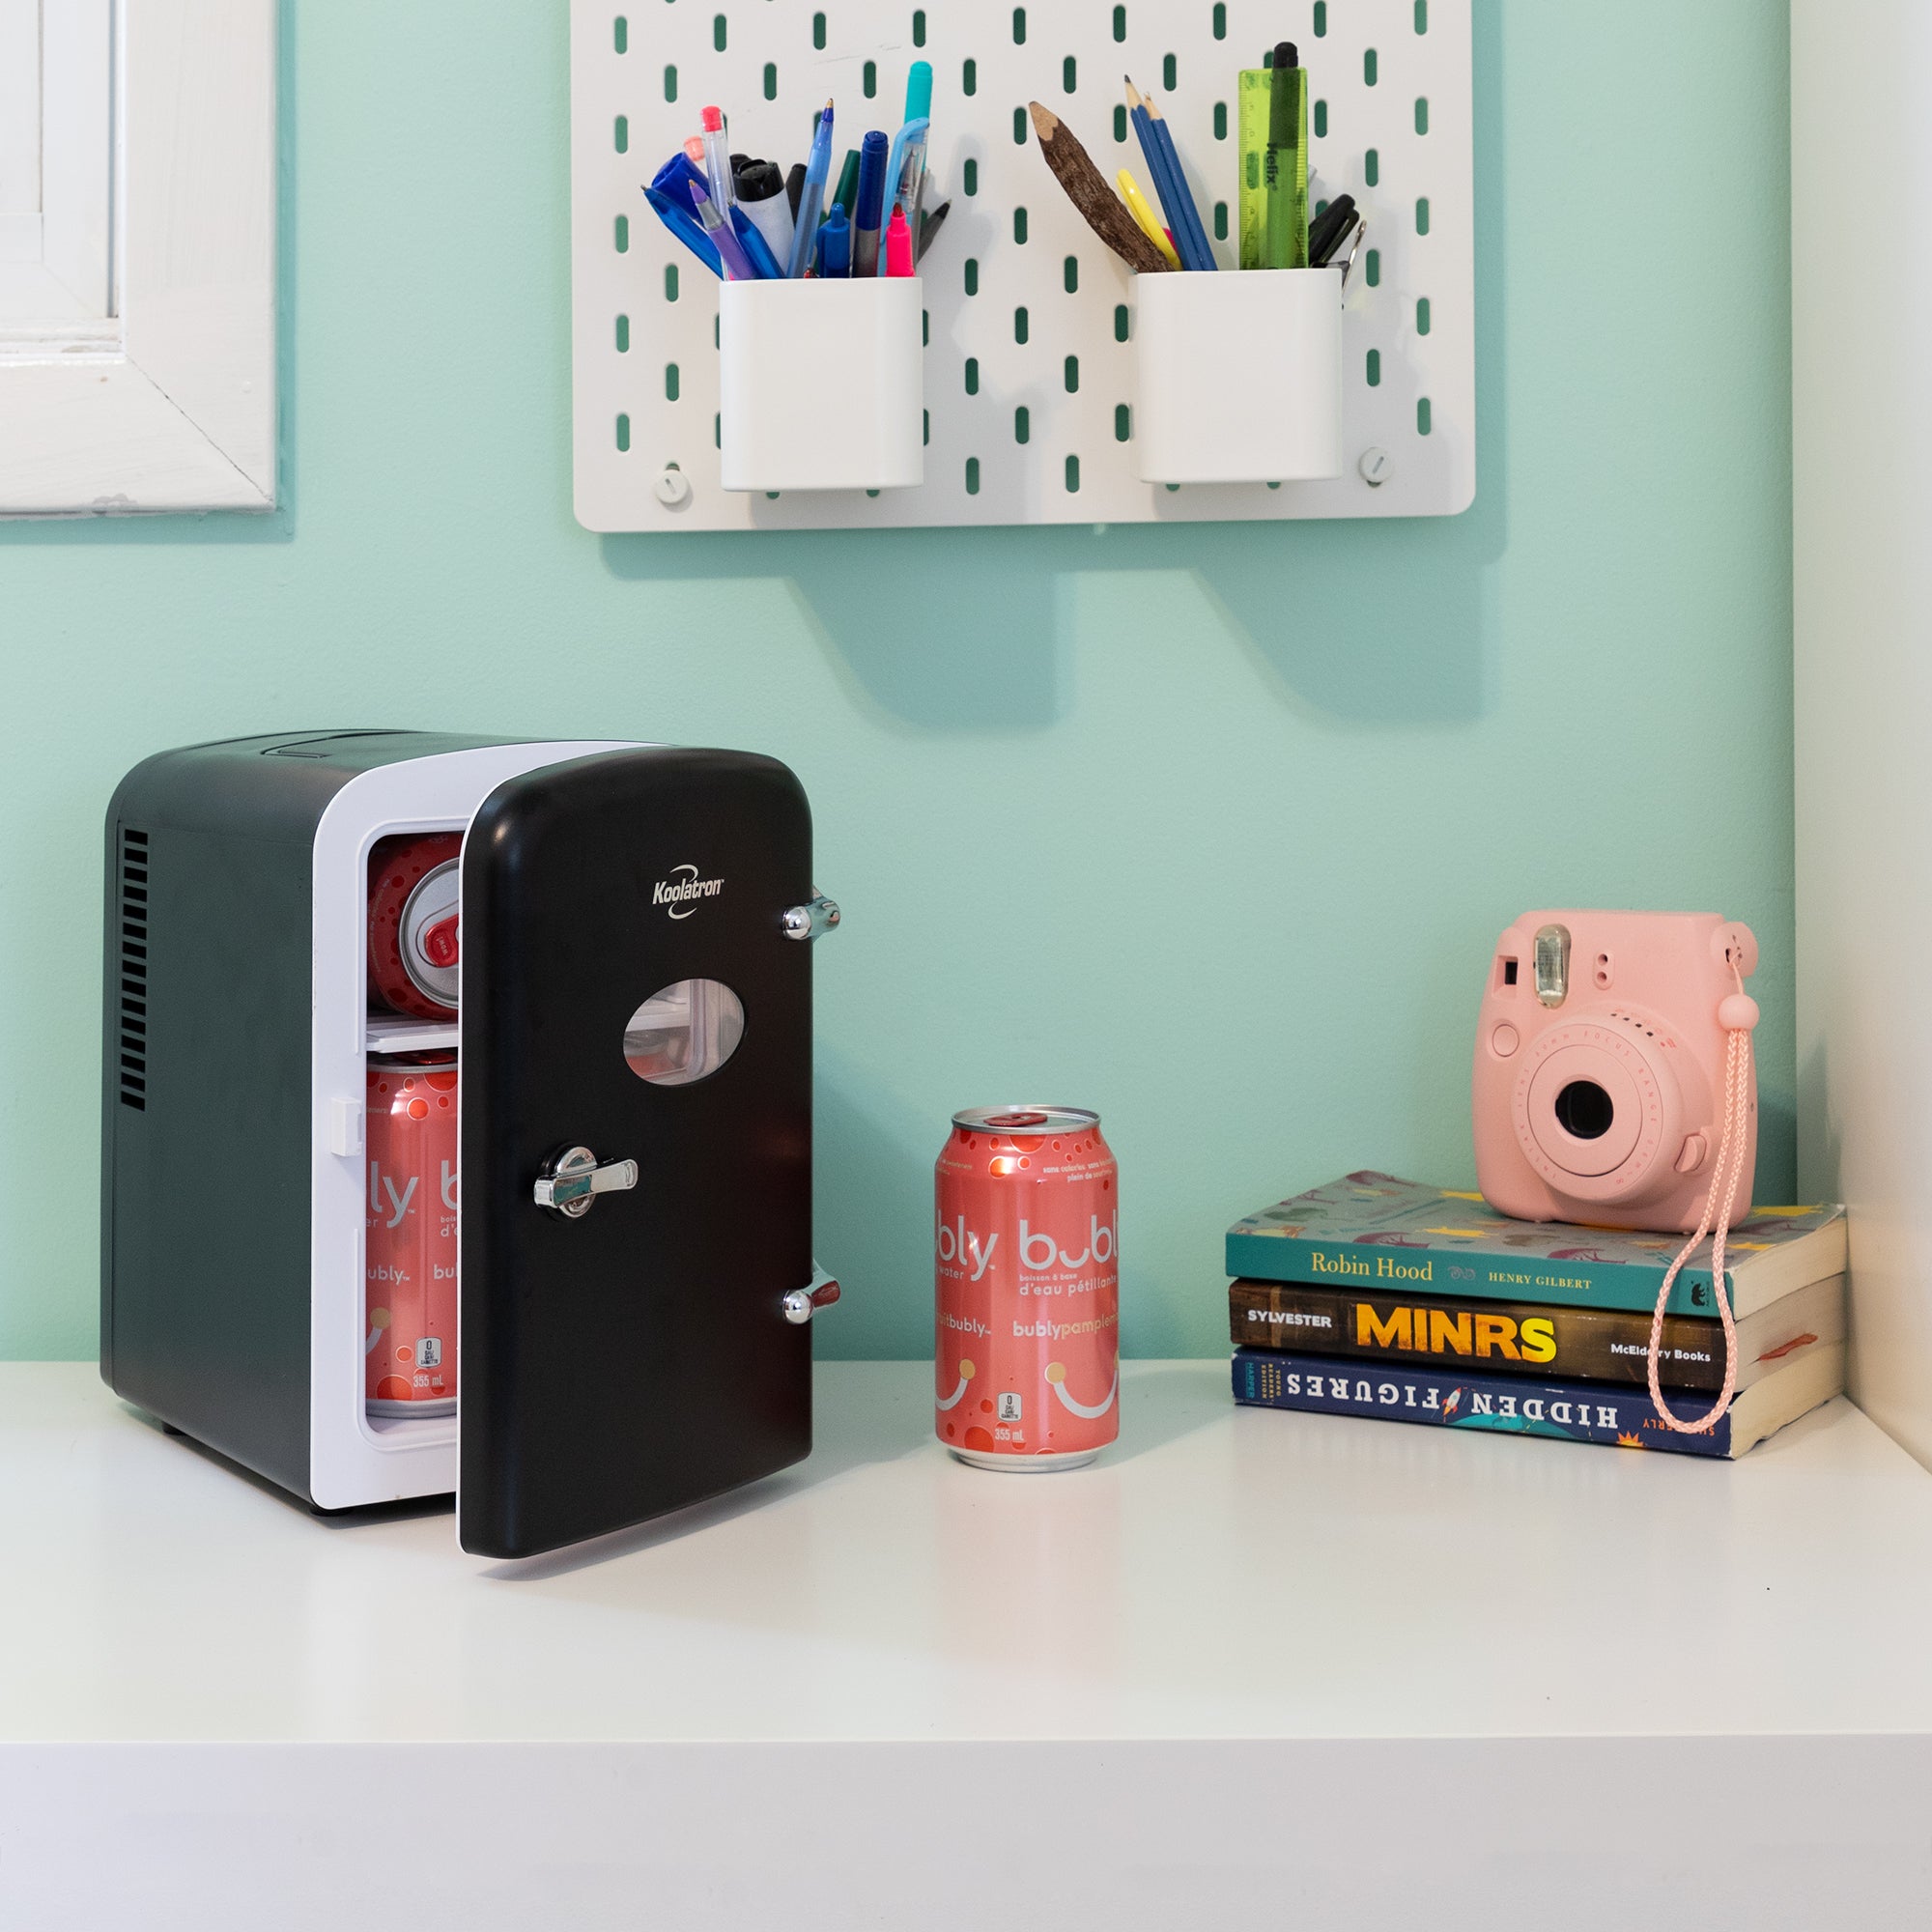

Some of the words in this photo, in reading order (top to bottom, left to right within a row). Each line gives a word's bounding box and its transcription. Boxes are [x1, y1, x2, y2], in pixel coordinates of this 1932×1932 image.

[1266, 142, 1280, 185] Helix
[652, 877, 722, 905] Koolatron
[936, 1208, 999, 1282] bly
[1311, 1252, 1371, 1276] Robin
[1377, 1257, 1434, 1281] Hood
[1489, 1271, 1531, 1286] HENRY
[1536, 1275, 1592, 1290] GILBERT
[1019, 1282, 1063, 1296] d'eau
[1248, 1309, 1332, 1328] SYLVESTER
[1355, 1303, 1557, 1363] MINRS
[1610, 1344, 1671, 1359] McEldry
[1674, 1349, 1711, 1362] Books
[412, 1375, 430, 1387] 355
[432, 1374, 444, 1386] mL
[1246, 1361, 1256, 1400] HARPER
[1287, 1373, 1440, 1410] FIGURES
[1007, 1395, 1012, 1406] 0
[1471, 1393, 1619, 1429] HIDDEN
[994, 1428, 1010, 1440] 355
[1011, 1429, 1025, 1441] mL
